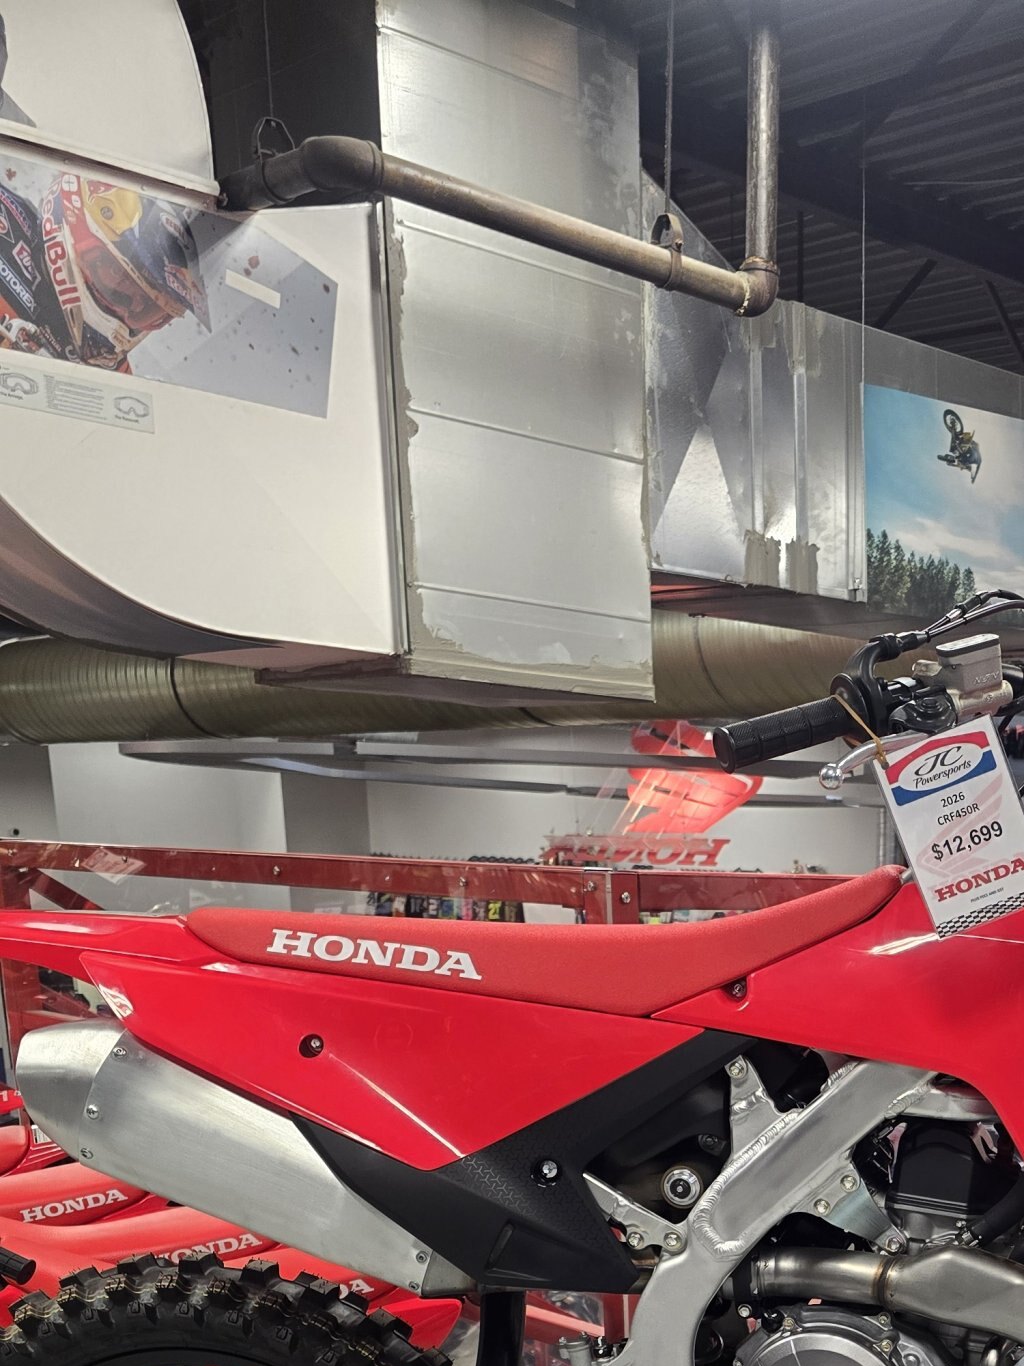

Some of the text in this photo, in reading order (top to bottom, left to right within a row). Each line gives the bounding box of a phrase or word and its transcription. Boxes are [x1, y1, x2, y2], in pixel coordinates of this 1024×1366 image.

[0, 261, 38, 313] OTOREX
[45, 240, 82, 310] Bull
[913, 758, 972, 789] Powersports
[915, 745, 964, 777] JC
[937, 802, 981, 826] CRF450R
[940, 791, 966, 808] 2026
[931, 820, 1003, 862] $12,699
[266, 928, 483, 981] HONDA
[20, 1188, 129, 1224] HONDA
